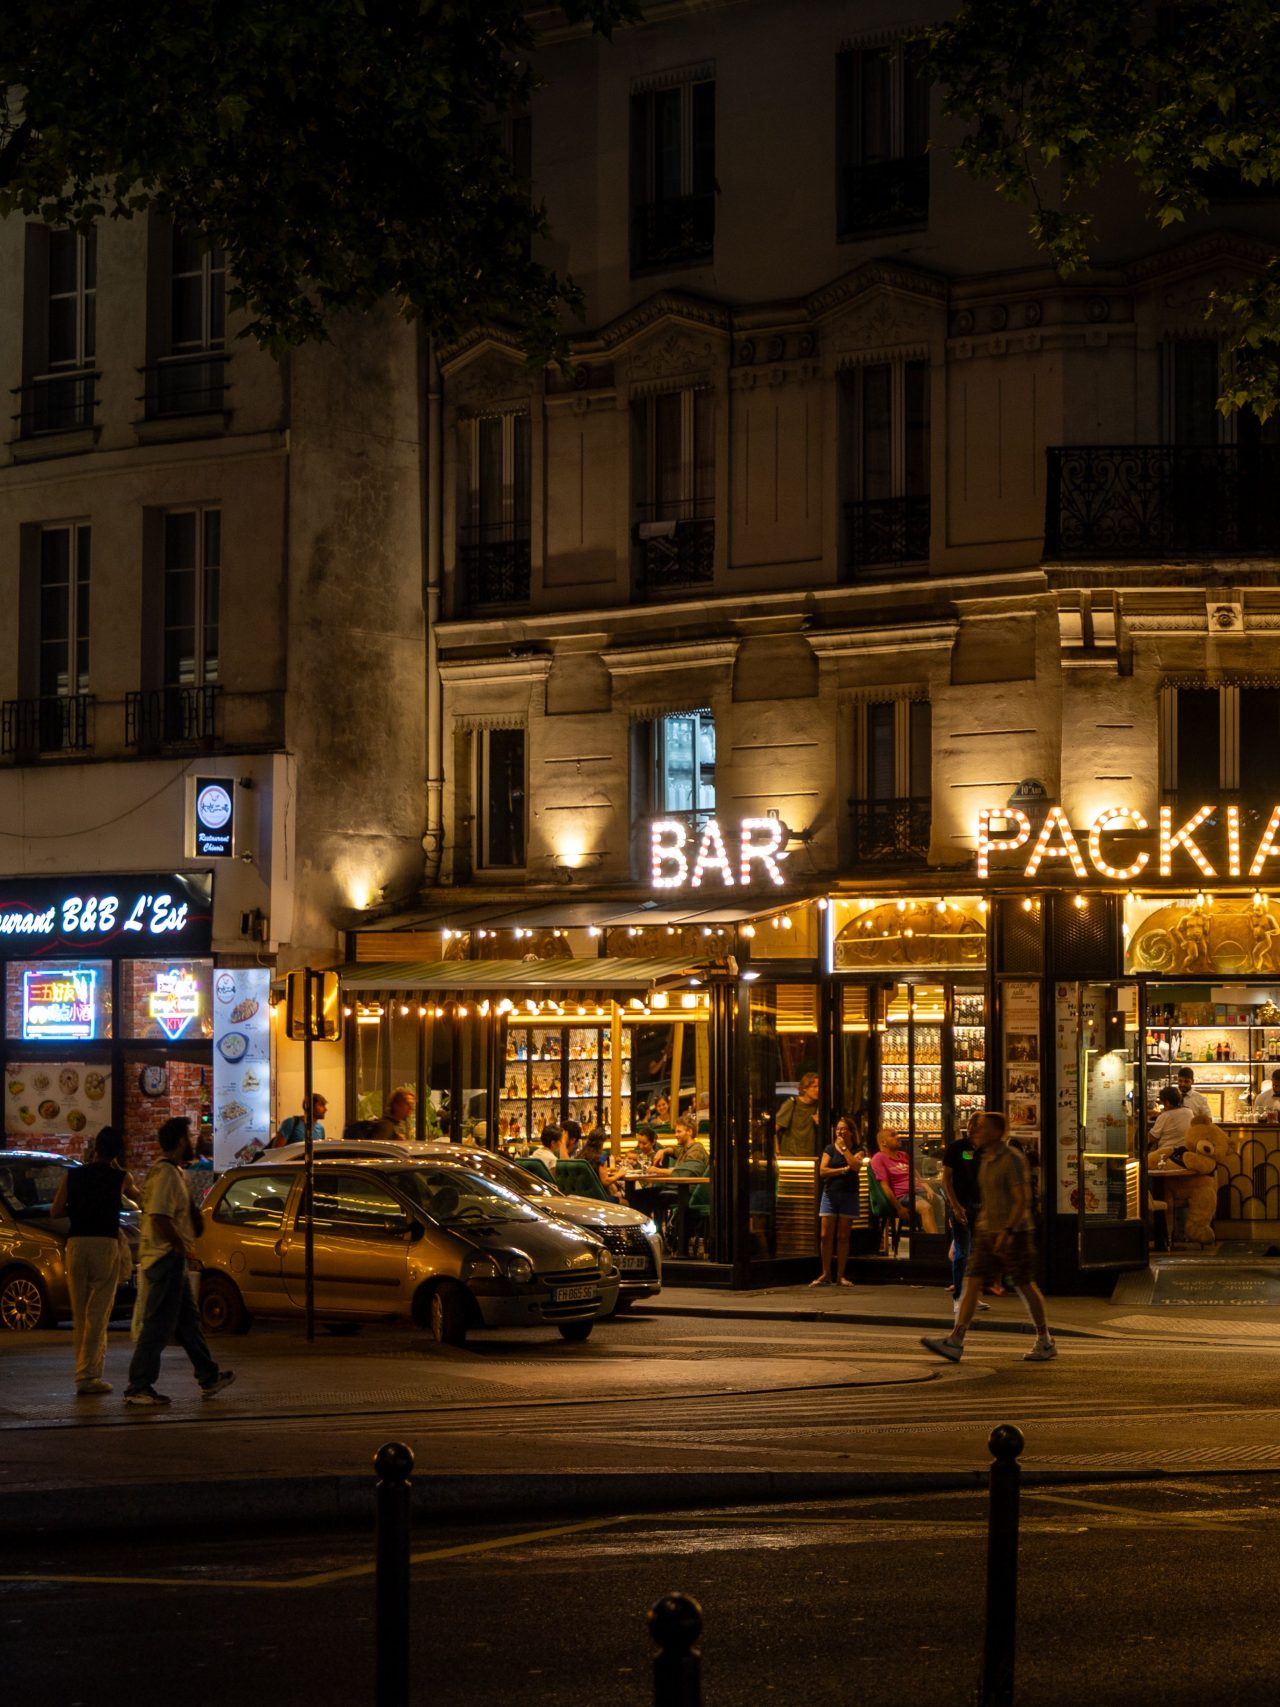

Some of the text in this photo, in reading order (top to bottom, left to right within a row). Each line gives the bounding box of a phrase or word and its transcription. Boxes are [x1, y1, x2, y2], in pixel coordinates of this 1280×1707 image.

[203, 843, 225, 853] Chinois
[651, 817, 785, 888] BAR
[0, 893, 189, 935] urant B&B L'Est
[166, 1018, 184, 1030] KTV
